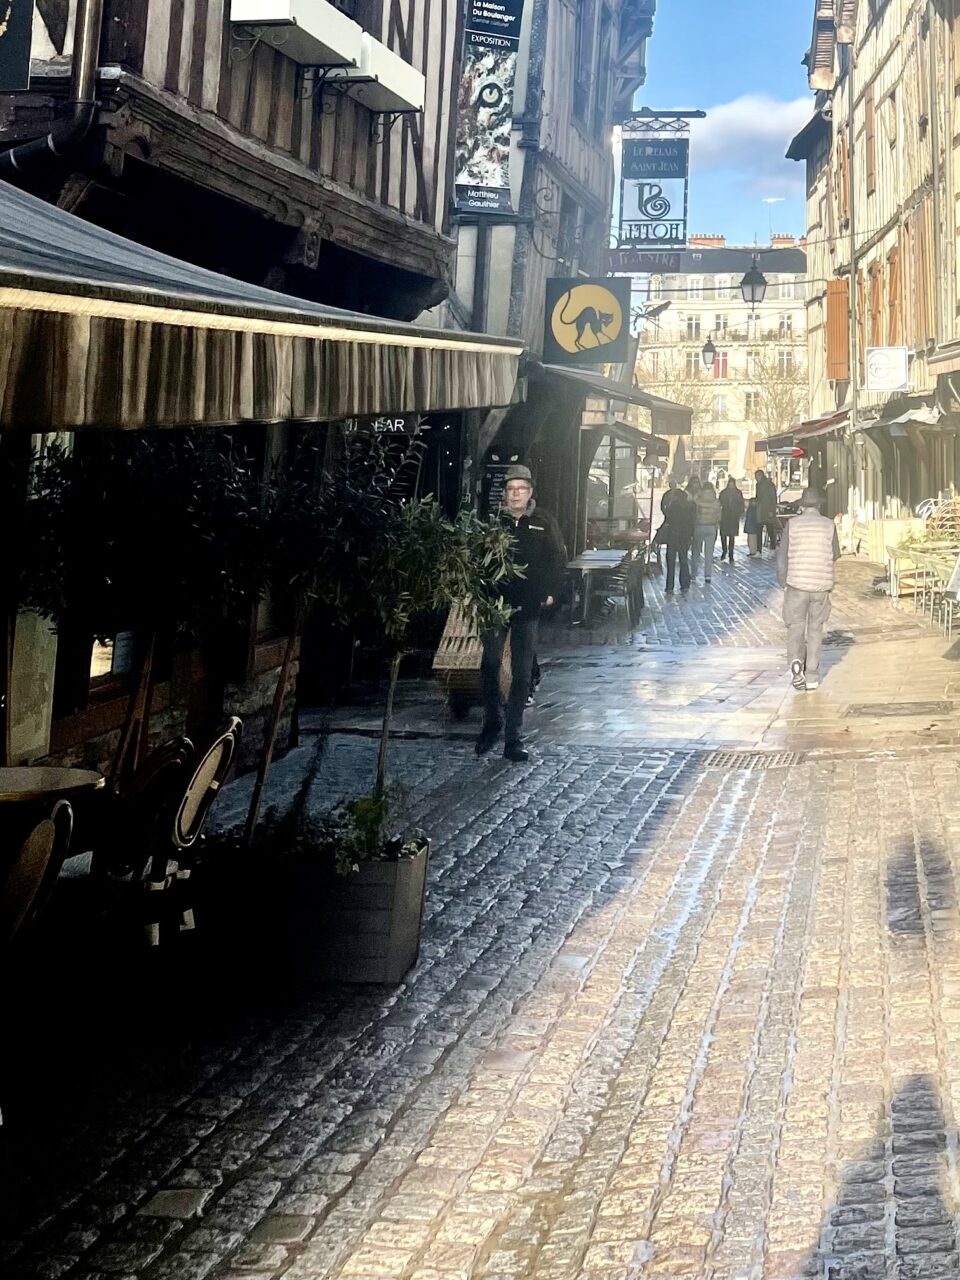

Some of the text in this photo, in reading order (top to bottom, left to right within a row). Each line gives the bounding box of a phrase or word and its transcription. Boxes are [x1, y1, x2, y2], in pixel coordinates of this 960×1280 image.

[473, 0, 506, 12] La Maison
[472, 8, 516, 22] Du Boulanger
[471, 34, 511, 47] EXPOSITION
[467, 190, 499, 200] Matthieu
[468, 199, 500, 209] Gauthier
